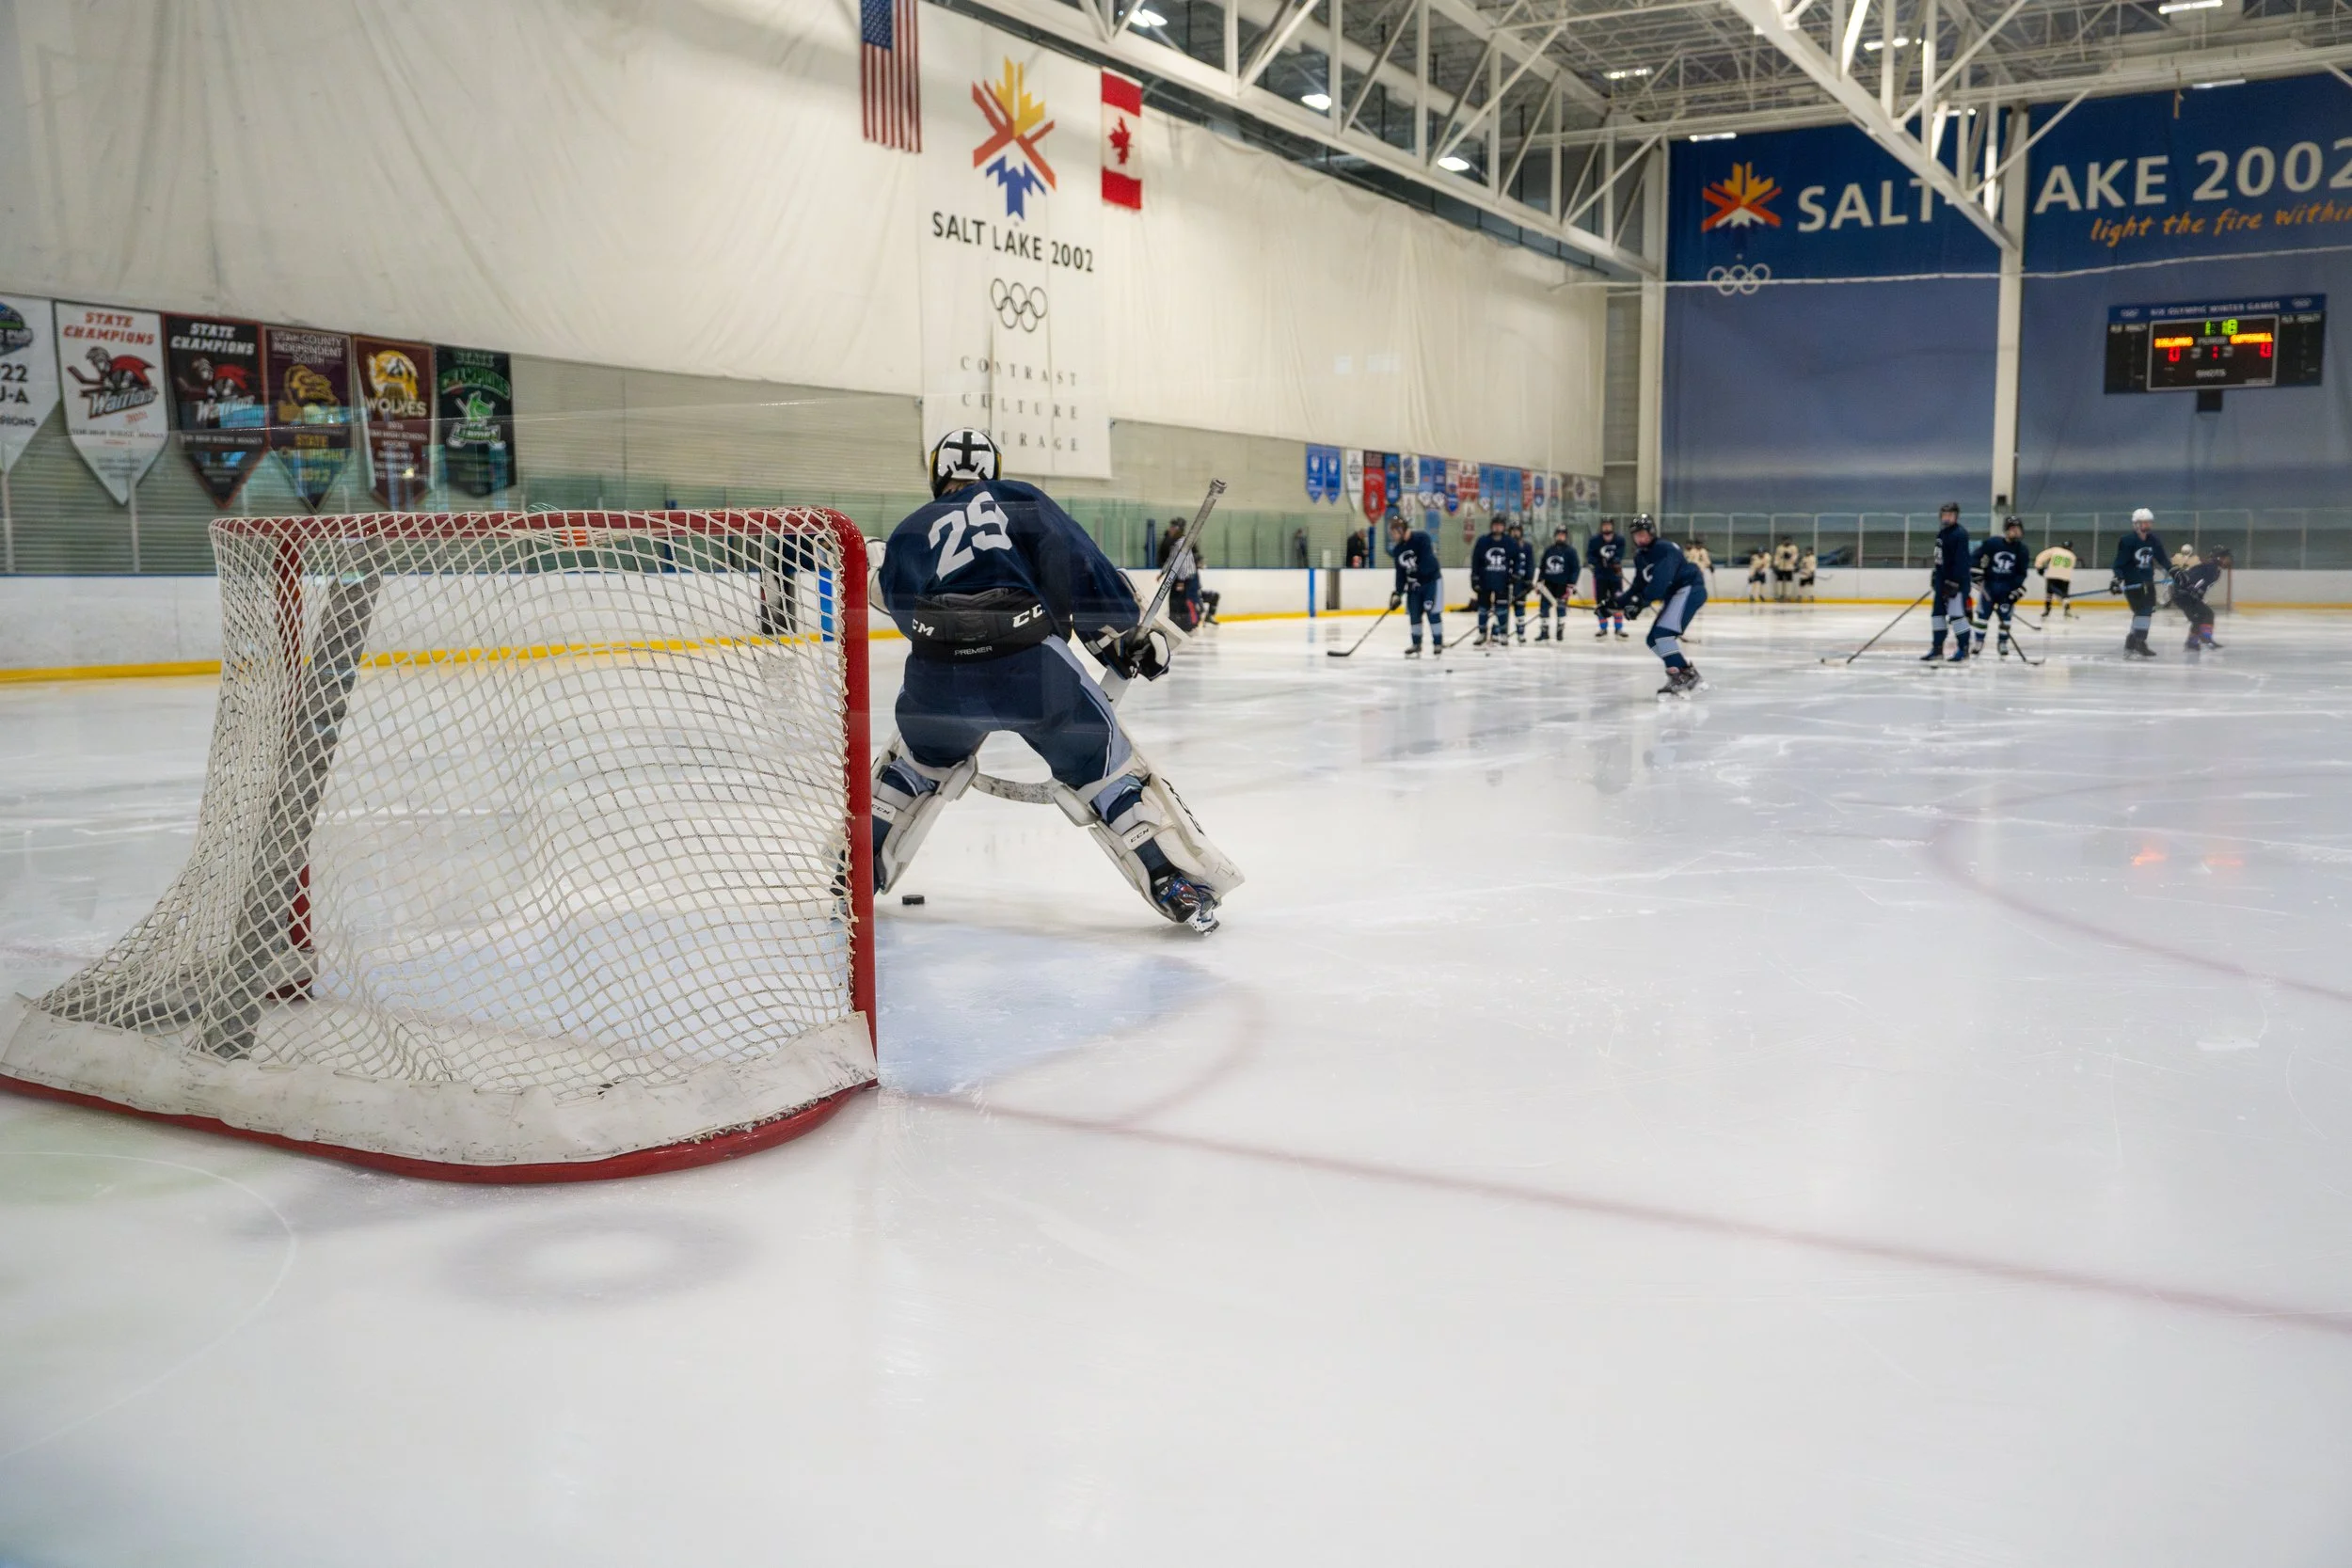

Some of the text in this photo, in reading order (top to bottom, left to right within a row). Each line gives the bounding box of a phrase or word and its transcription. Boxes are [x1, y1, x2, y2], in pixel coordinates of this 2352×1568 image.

[1798, 136, 2352, 232] SALT AKE 2002
[2090, 214, 2155, 248] light
[2163, 210, 2205, 235] the
[2213, 208, 2263, 236] fire
[932, 210, 1093, 273] SALT LAKE 2002
[2247, 300, 2280, 311] GAMES
[85, 311, 134, 328] STATE
[62, 325, 155, 346] CHAMPIONS
[189, 322, 235, 339] STATE
[170, 335, 255, 356] CHAMPIONS
[88, 385, 159, 420] Warriors
[365, 396, 428, 418] WOLVES
[954, 645, 993, 657] PREMIER
[871, 803, 890, 815] CCM
[1130, 828, 1150, 844] CCM
